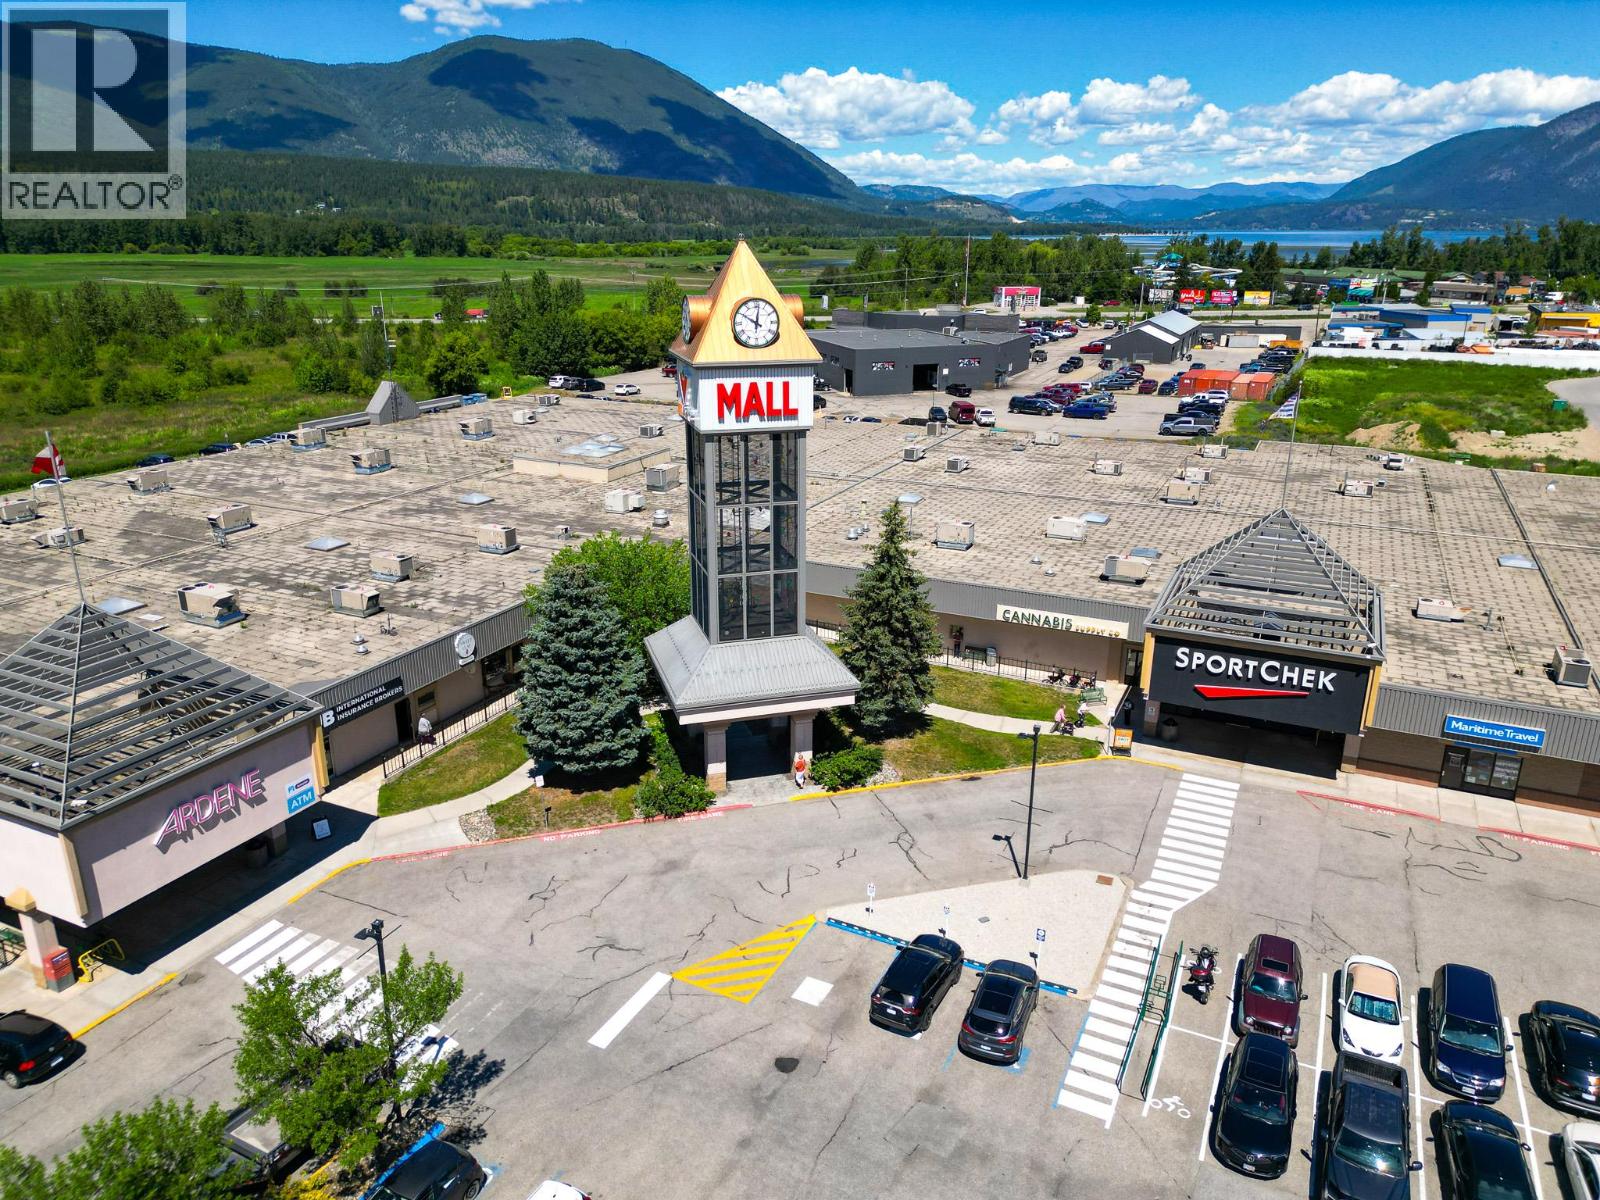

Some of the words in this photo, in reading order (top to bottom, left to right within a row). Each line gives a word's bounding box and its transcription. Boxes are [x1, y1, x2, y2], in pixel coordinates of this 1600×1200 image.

[717, 381, 799, 420] MALL
[1002, 609, 1073, 631] CANNABIS
[336, 686, 387, 712] INTERNATIONAL
[337, 700, 374, 721] INSURANCE
[374, 686, 403, 703] BROKERS
[1451, 720, 1504, 737] Maritime
[1504, 728, 1539, 743] Travel
[153, 769, 262, 846] ARDENE
[291, 791, 312, 809] ATM
